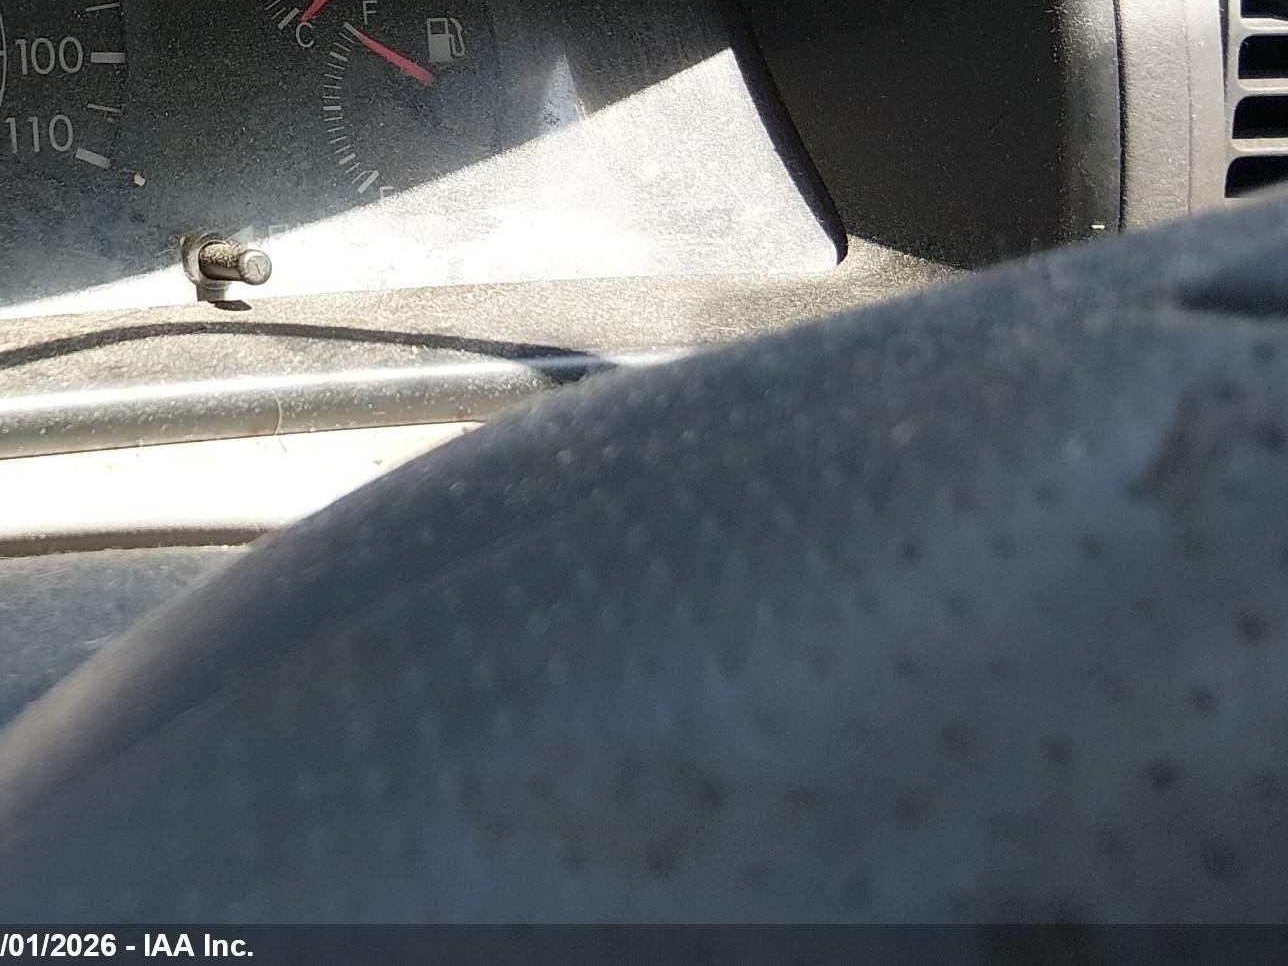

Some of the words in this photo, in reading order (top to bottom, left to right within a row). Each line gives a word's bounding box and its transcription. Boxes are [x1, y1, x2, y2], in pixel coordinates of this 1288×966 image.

[362, 0, 378, 25] F
[295, 22, 315, 48] C
[16, 37, 83, 74] 100
[6, 115, 74, 154] 110
